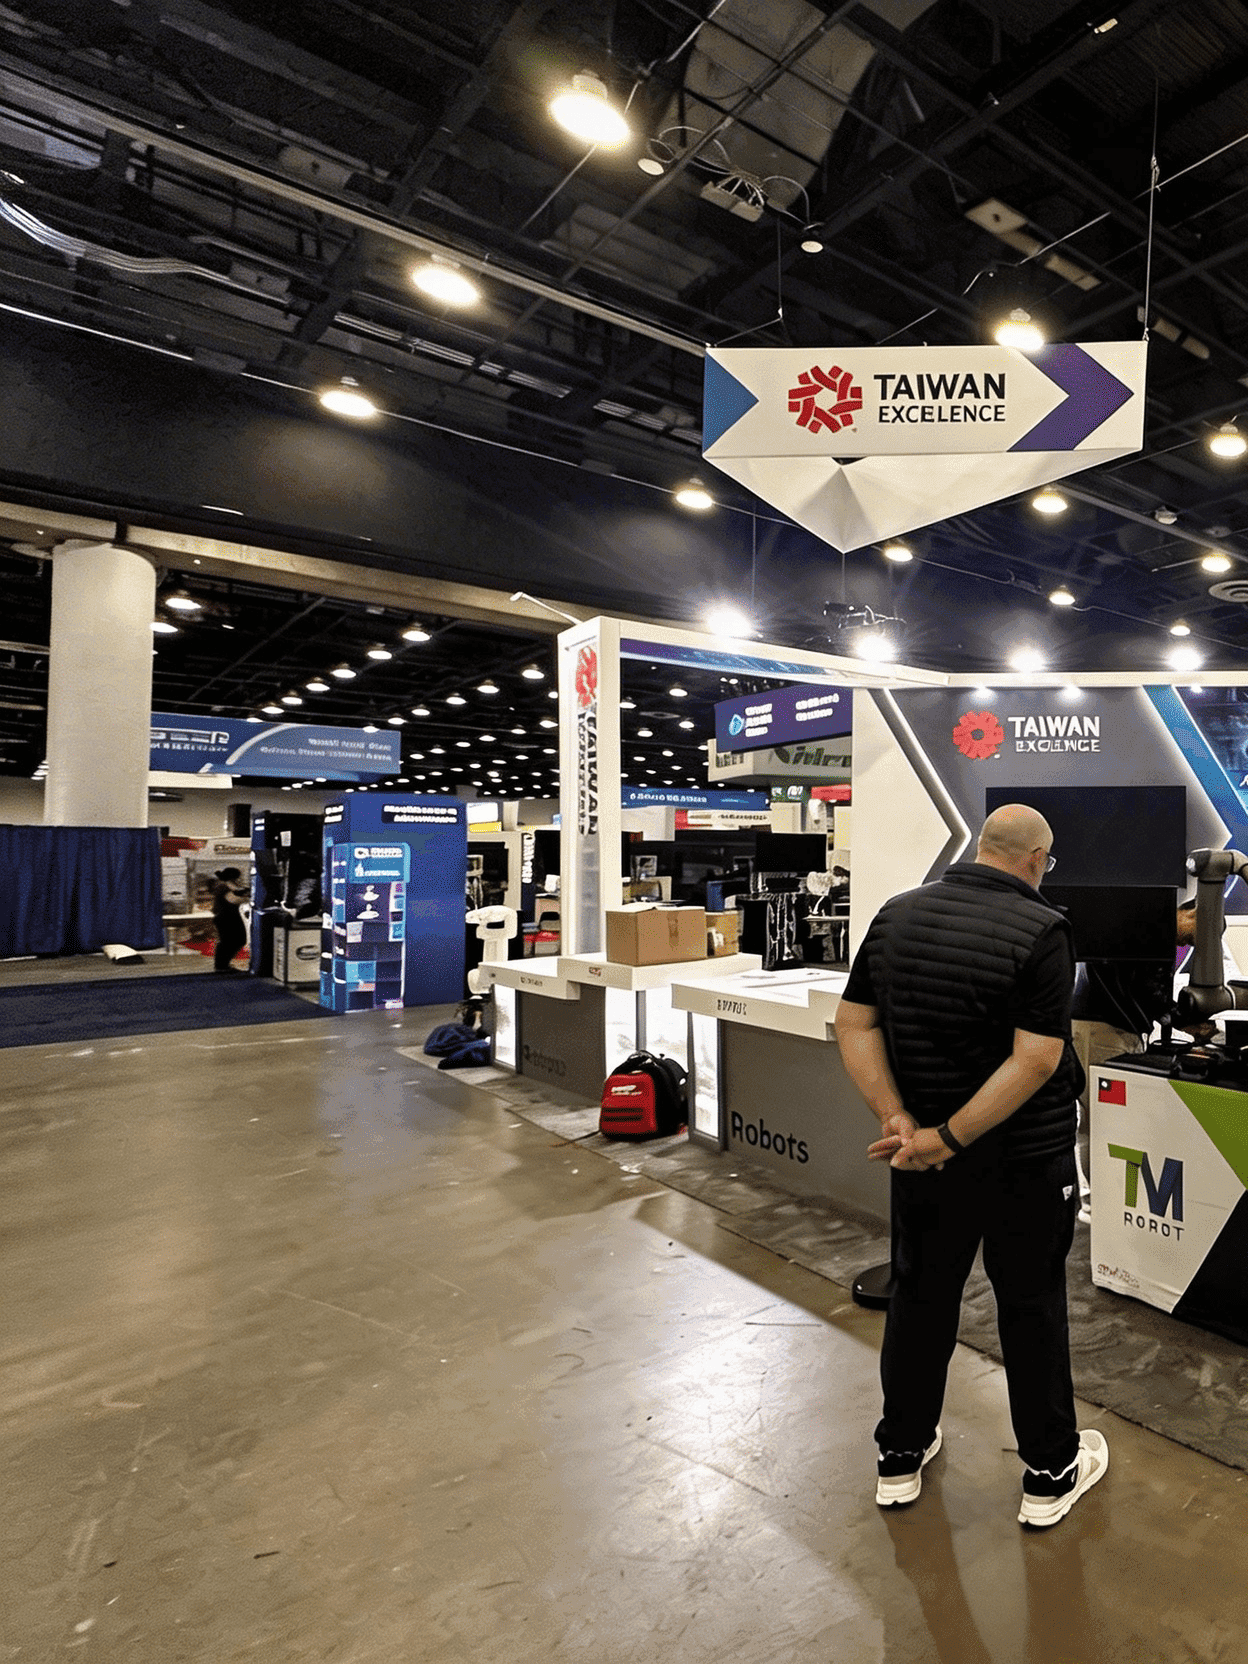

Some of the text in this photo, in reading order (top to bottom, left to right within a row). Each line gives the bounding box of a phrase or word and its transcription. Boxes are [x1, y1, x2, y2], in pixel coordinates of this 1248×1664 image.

[873, 373, 1006, 400] TAIWAN
[1008, 716, 1100, 738] TAIWAN
[731, 1111, 809, 1164] Robots
[1107, 1143, 1183, 1222] TM
